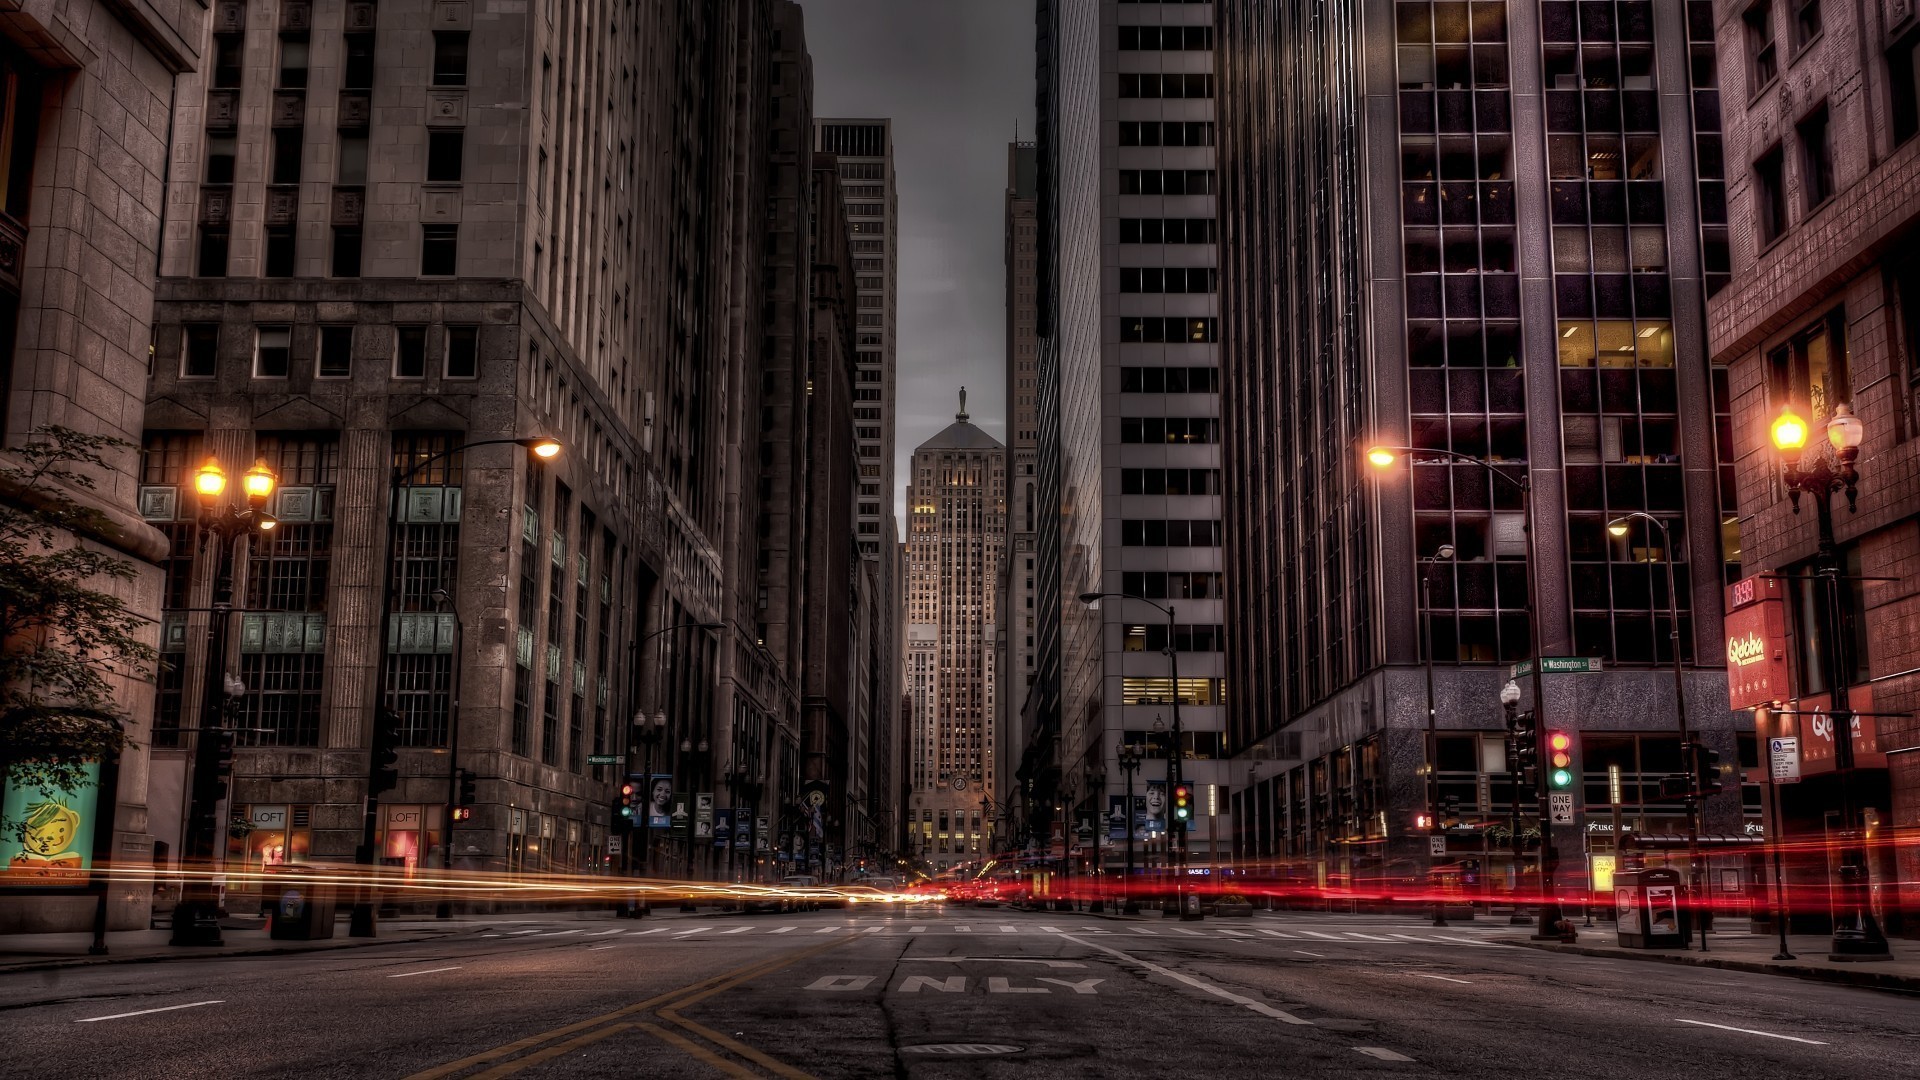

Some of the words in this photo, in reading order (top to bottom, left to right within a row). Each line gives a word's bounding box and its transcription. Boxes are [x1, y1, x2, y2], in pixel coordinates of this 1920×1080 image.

[1728, 631, 1764, 666] Qdoba
[1548, 659, 1582, 671] Washington
[254, 812, 284, 823] LOFT
[389, 812, 419, 823] LOFT
[803, 975, 1106, 994] ONLY
